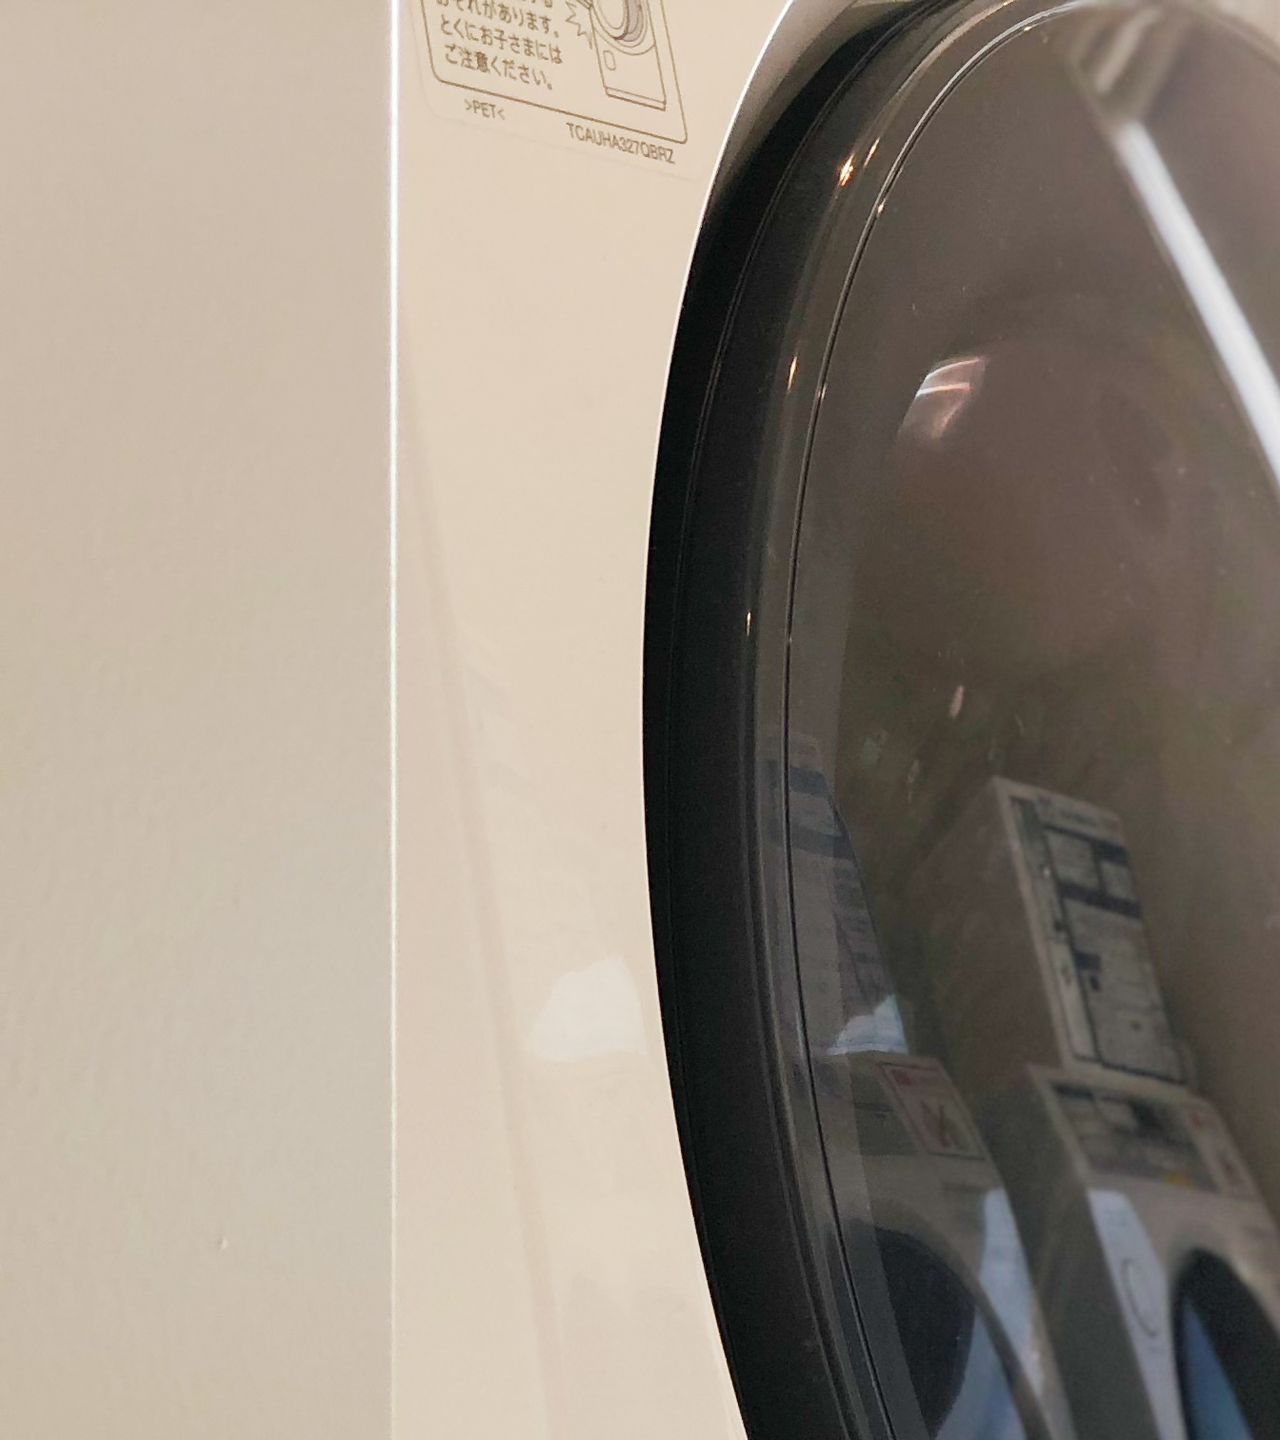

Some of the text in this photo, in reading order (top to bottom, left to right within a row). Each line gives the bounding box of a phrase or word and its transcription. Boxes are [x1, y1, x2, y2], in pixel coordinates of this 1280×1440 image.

[440, 13, 563, 65] とくにお子さまには
[444, 42, 553, 91] ご注意ください。
